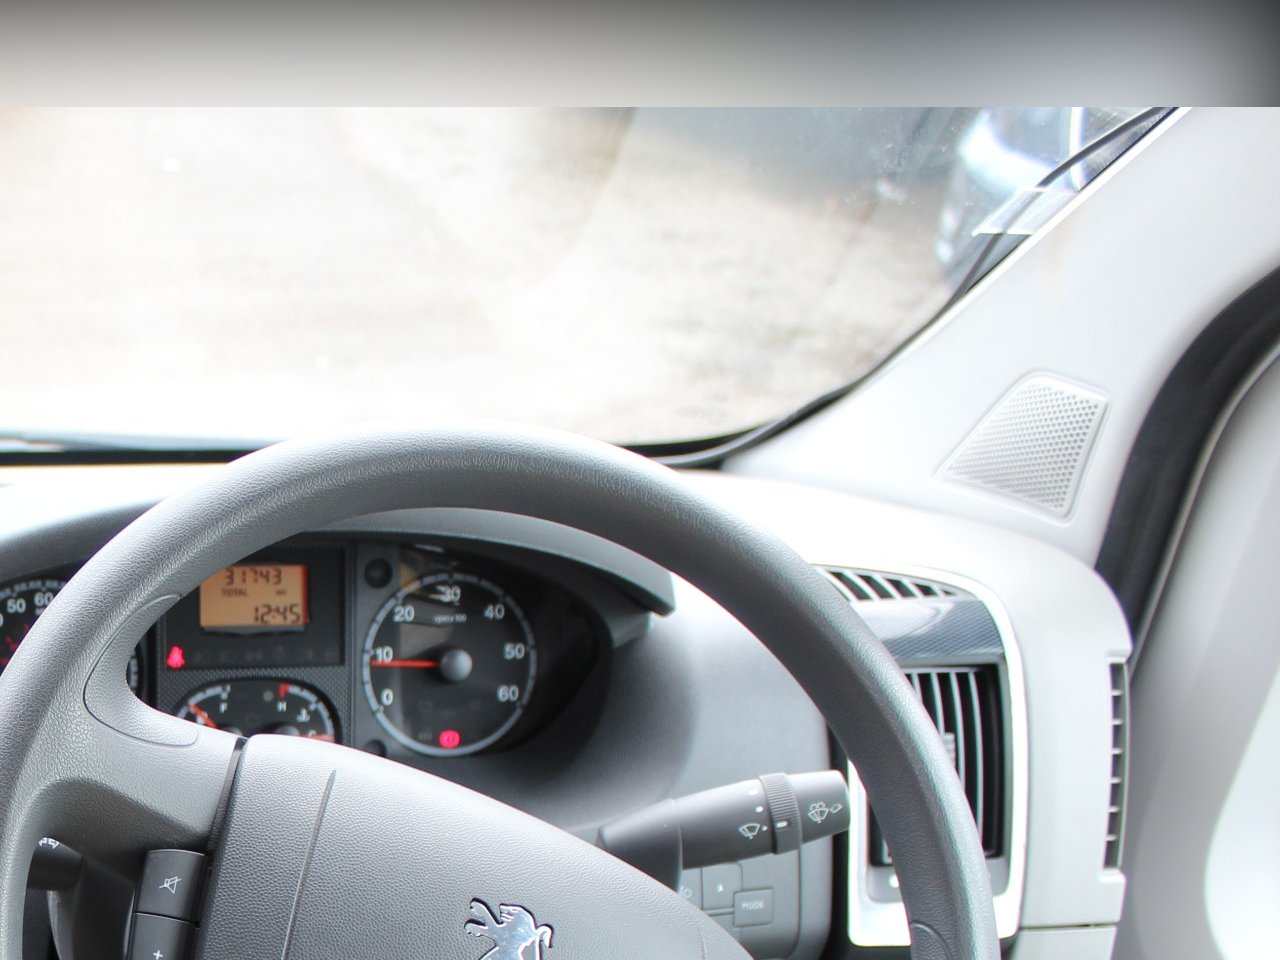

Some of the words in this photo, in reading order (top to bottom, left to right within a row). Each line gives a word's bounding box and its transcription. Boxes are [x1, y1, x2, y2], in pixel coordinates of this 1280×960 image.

[224, 568, 283, 586] 31743
[34, 592, 54, 607] 60
[222, 588, 249, 598] TOTAL
[7, 598, 27, 614] 50
[254, 604, 301, 624] 12:45
[393, 605, 415, 623] 20
[484, 603, 505, 620] 40
[375, 646, 393, 662] 10
[504, 642, 526, 660] 50
[381, 689, 393, 705] 0
[497, 685, 520, 702] 60
[277, 701, 287, 712] H
[741, 901, 764, 910] MODE
